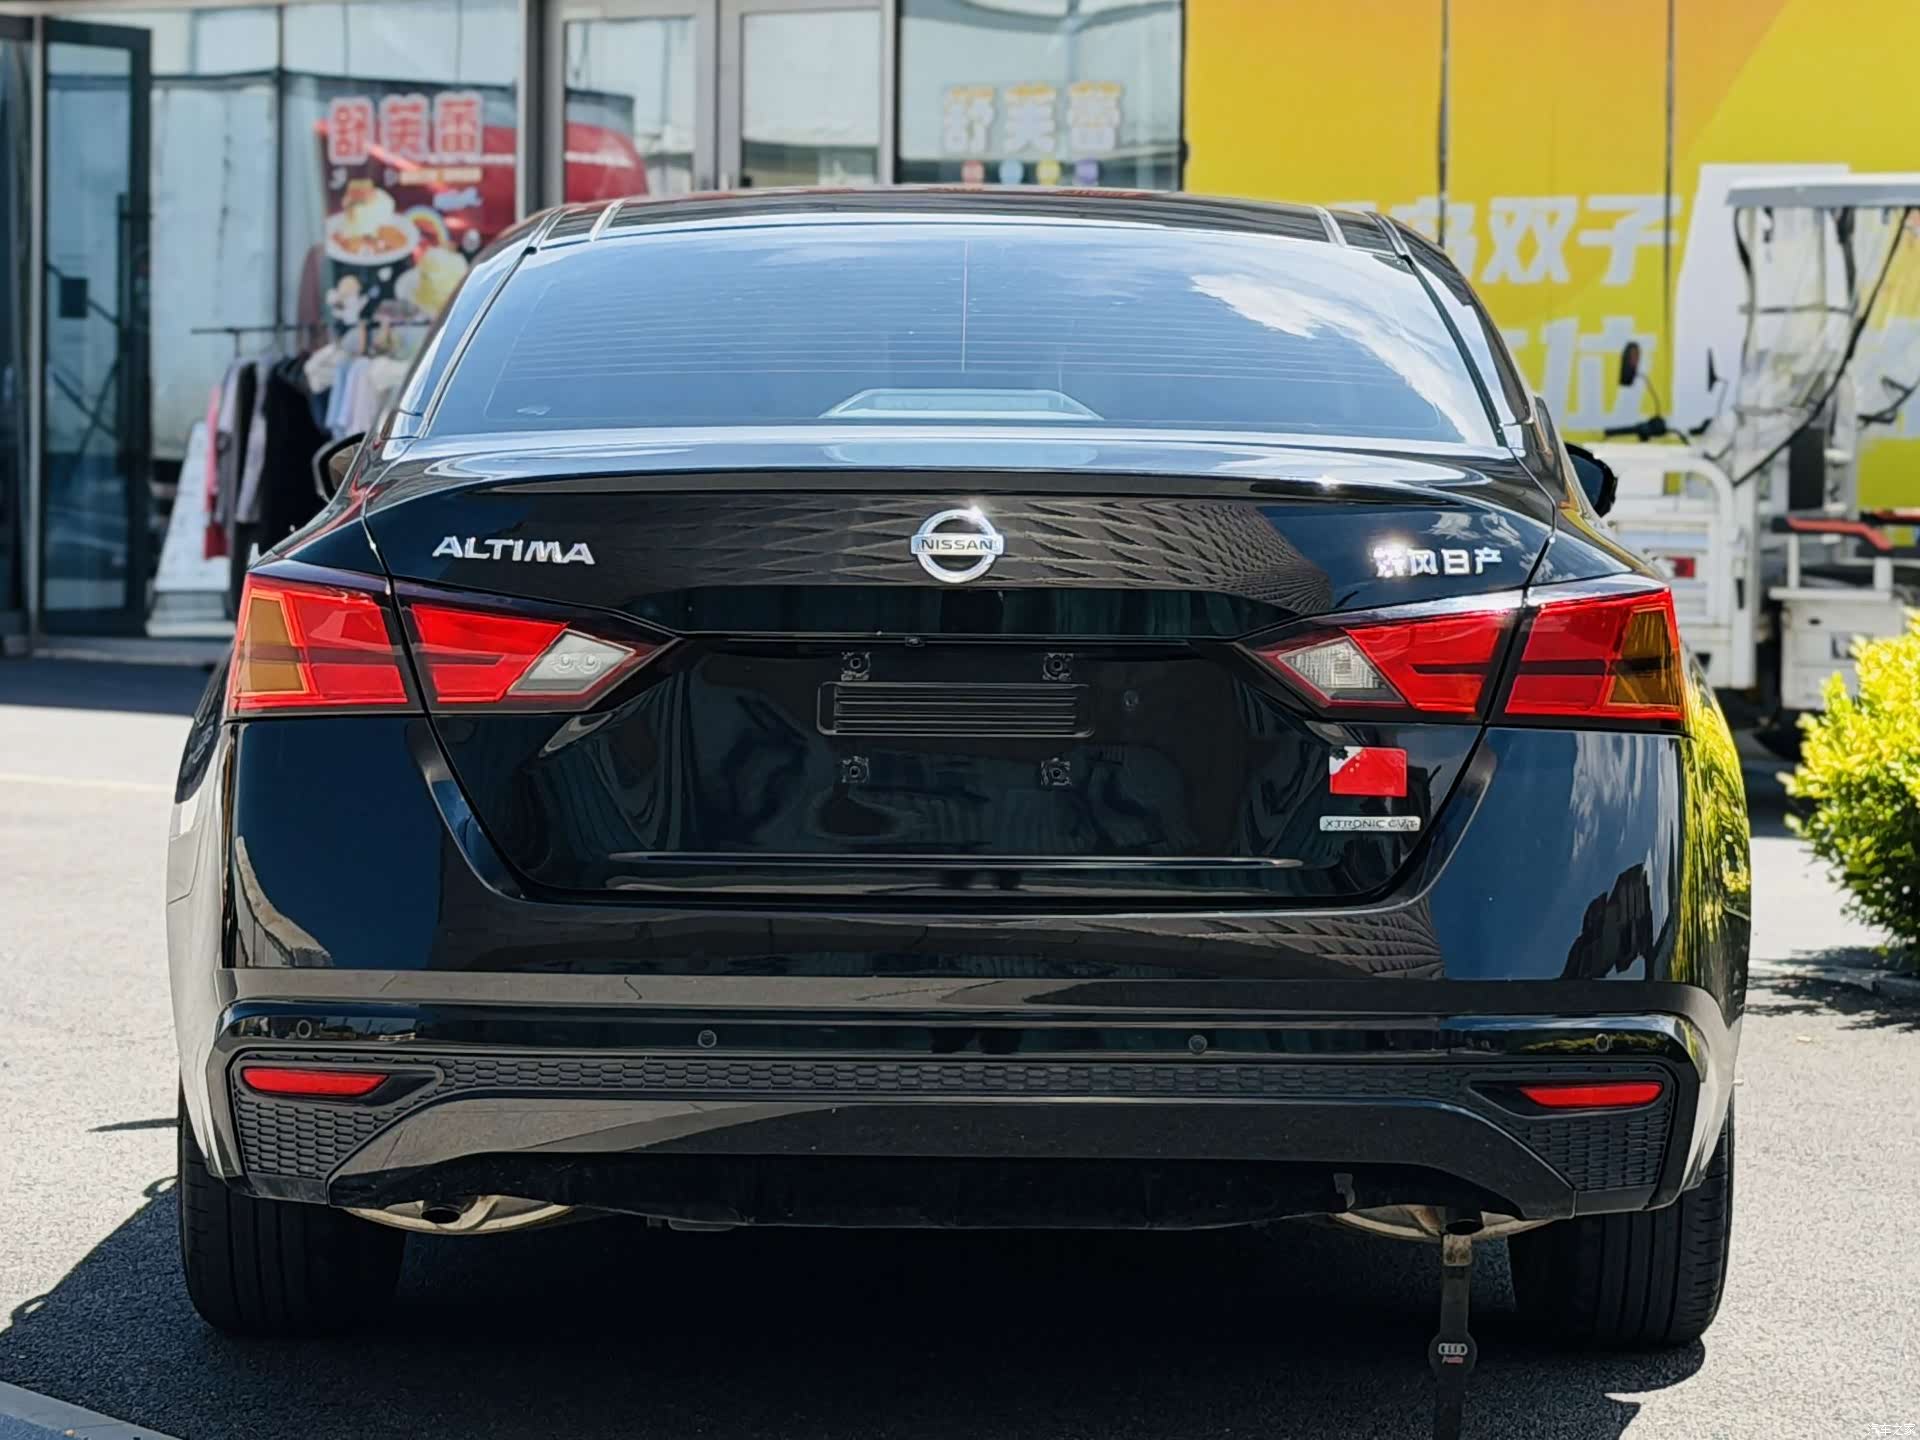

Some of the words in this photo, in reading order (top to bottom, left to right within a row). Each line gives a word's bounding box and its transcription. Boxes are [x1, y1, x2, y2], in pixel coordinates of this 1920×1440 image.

[431, 535, 596, 565] ALTIMA
[921, 538, 993, 551] NISSAN
[1326, 819, 1386, 830] XTRONIC
